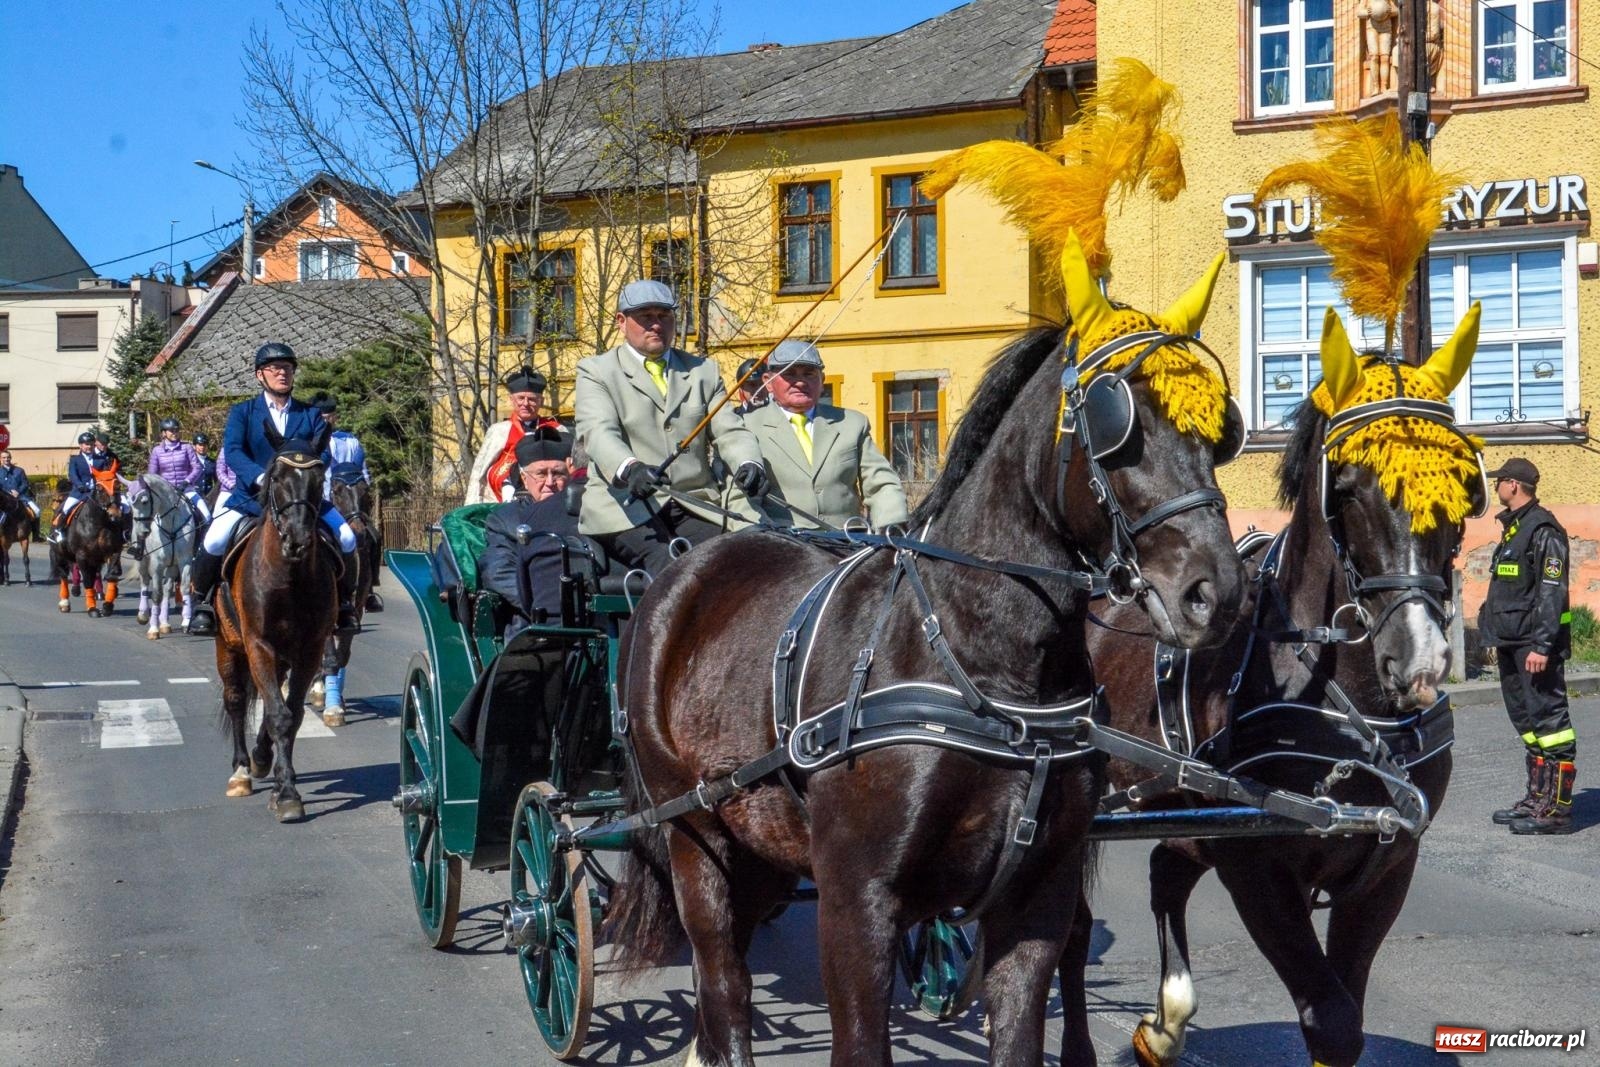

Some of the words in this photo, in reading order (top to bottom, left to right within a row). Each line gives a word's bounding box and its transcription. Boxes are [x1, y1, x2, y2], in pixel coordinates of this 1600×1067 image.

[1222, 193, 1338, 238] STU
[1440, 174, 1588, 221] RYZUR
[0, 433, 8, 443] OP
